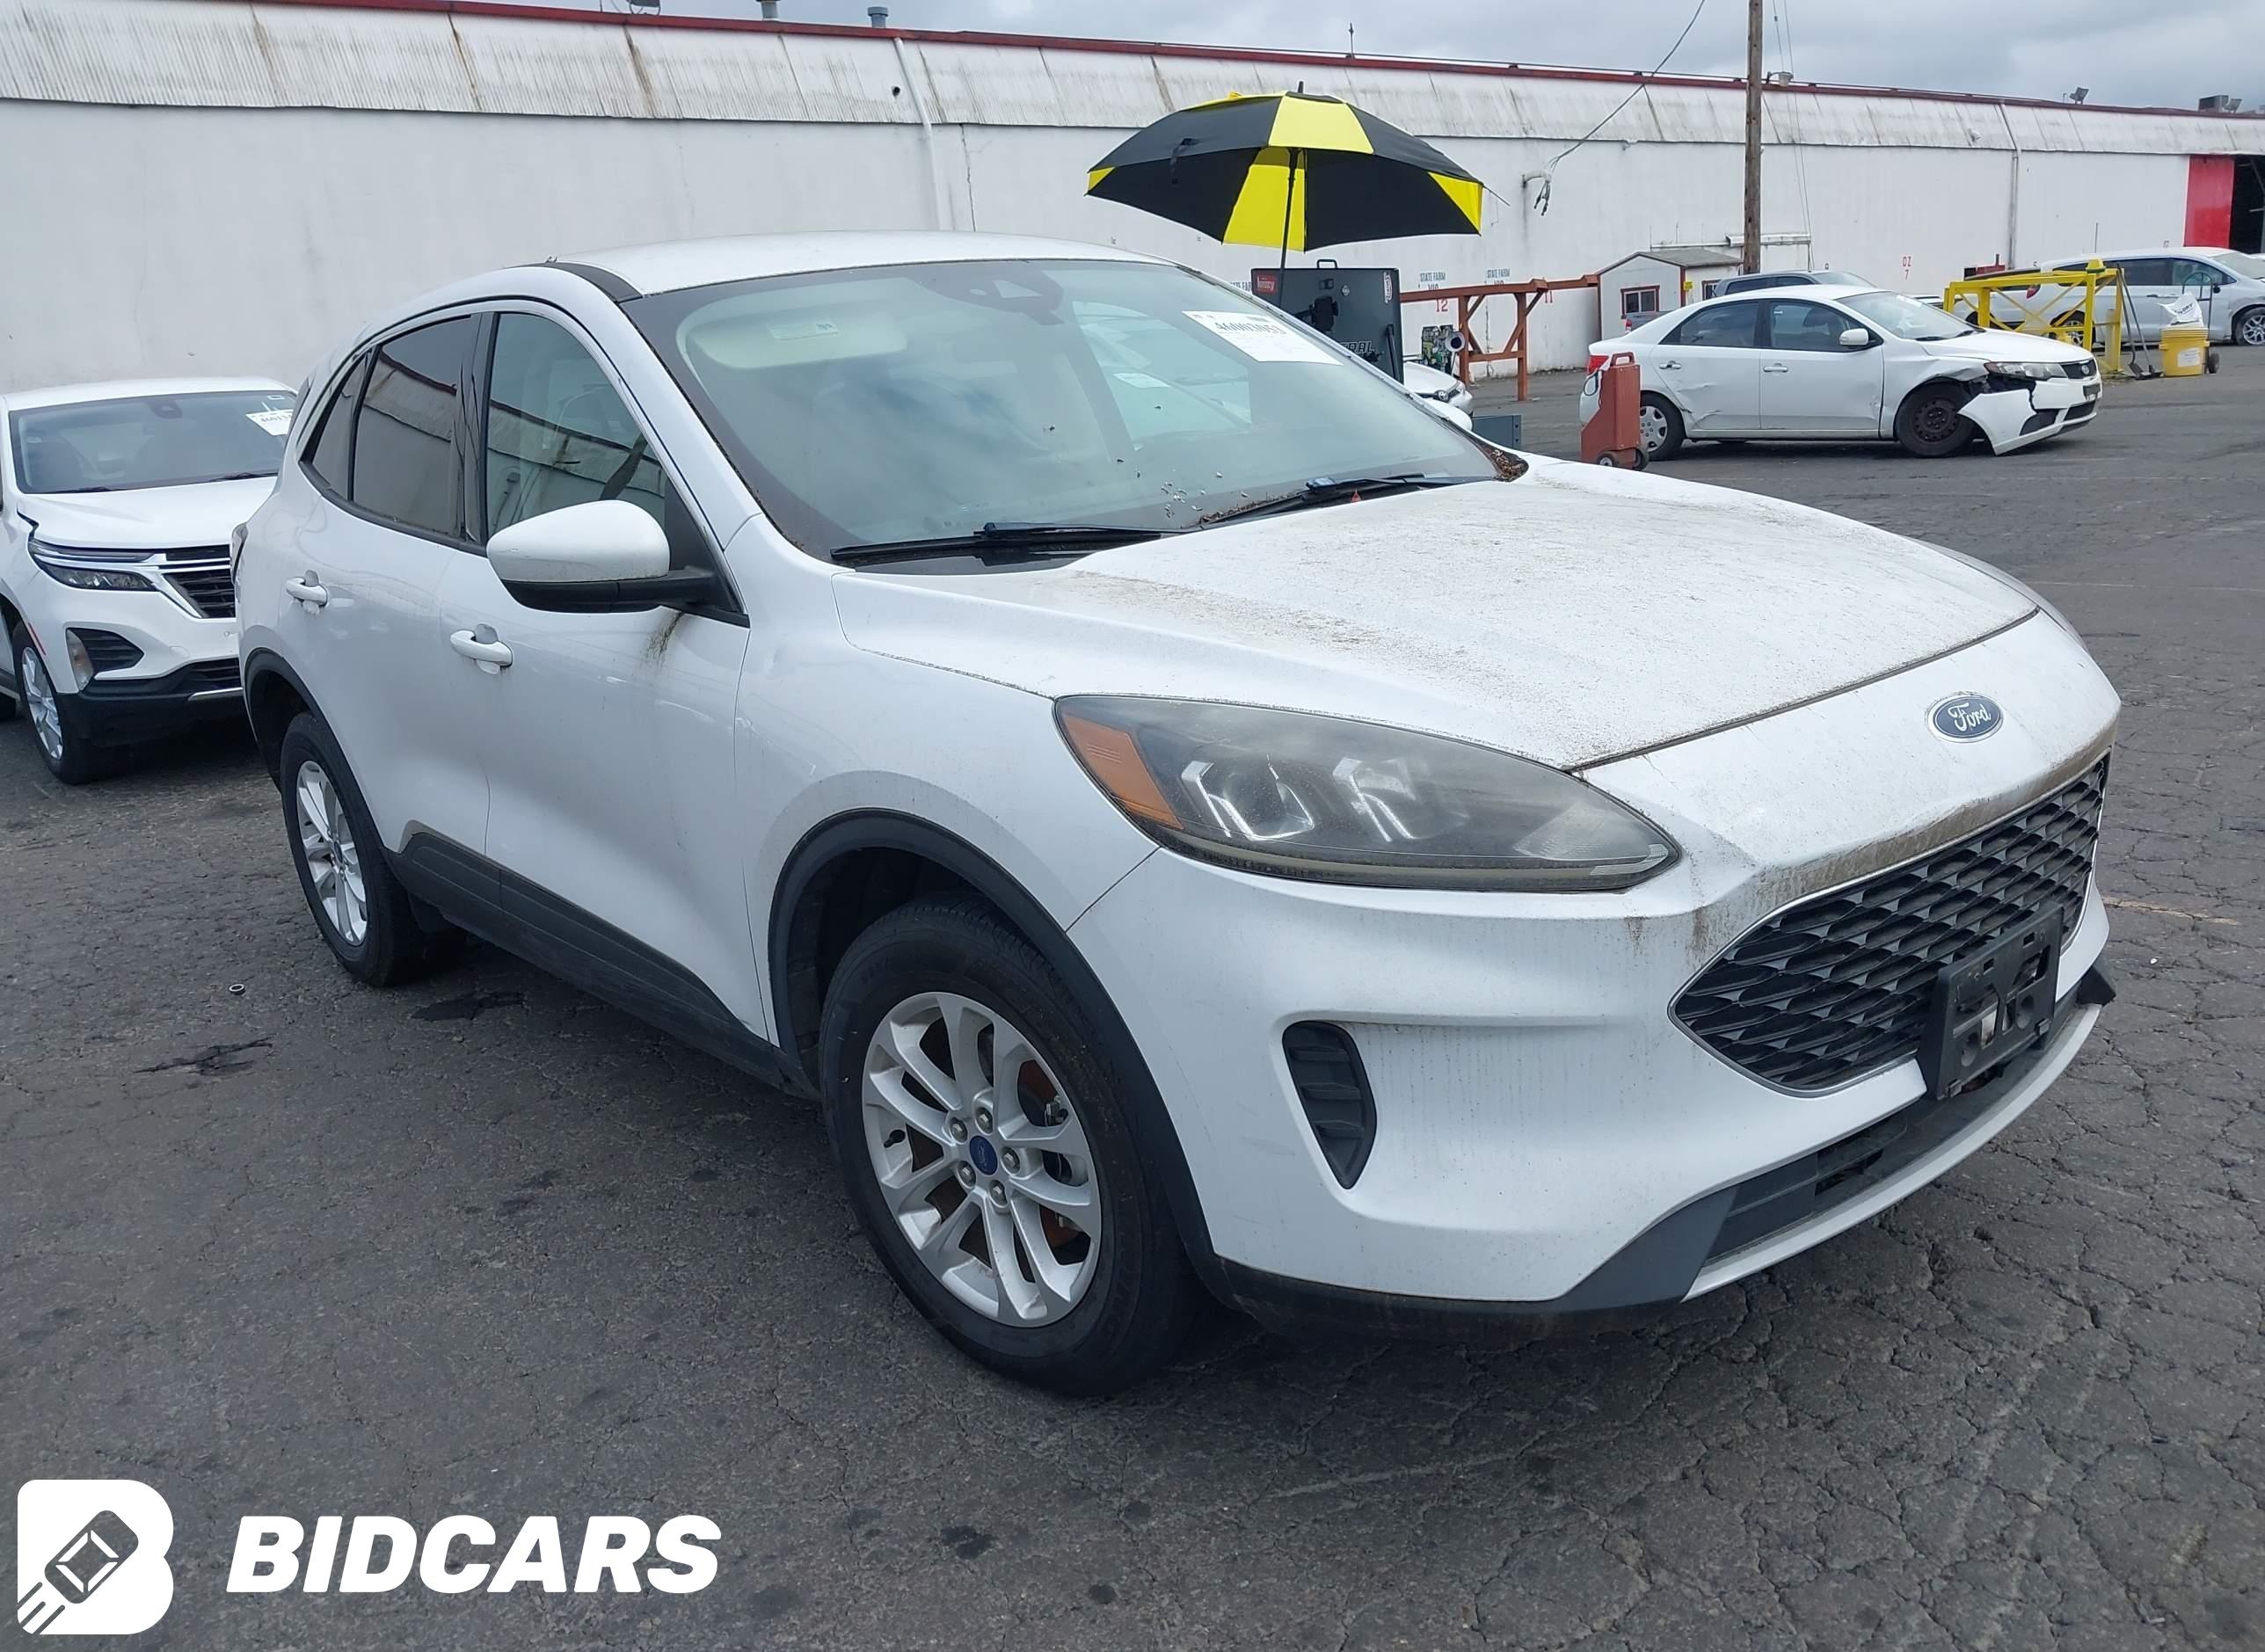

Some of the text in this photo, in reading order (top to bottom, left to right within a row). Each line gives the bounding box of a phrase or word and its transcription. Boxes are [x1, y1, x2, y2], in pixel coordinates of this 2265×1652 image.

[1420, 272, 1446, 282] STATE FARM
[1436, 297, 1448, 312] 12
[1948, 702, 1992, 731] Ford
